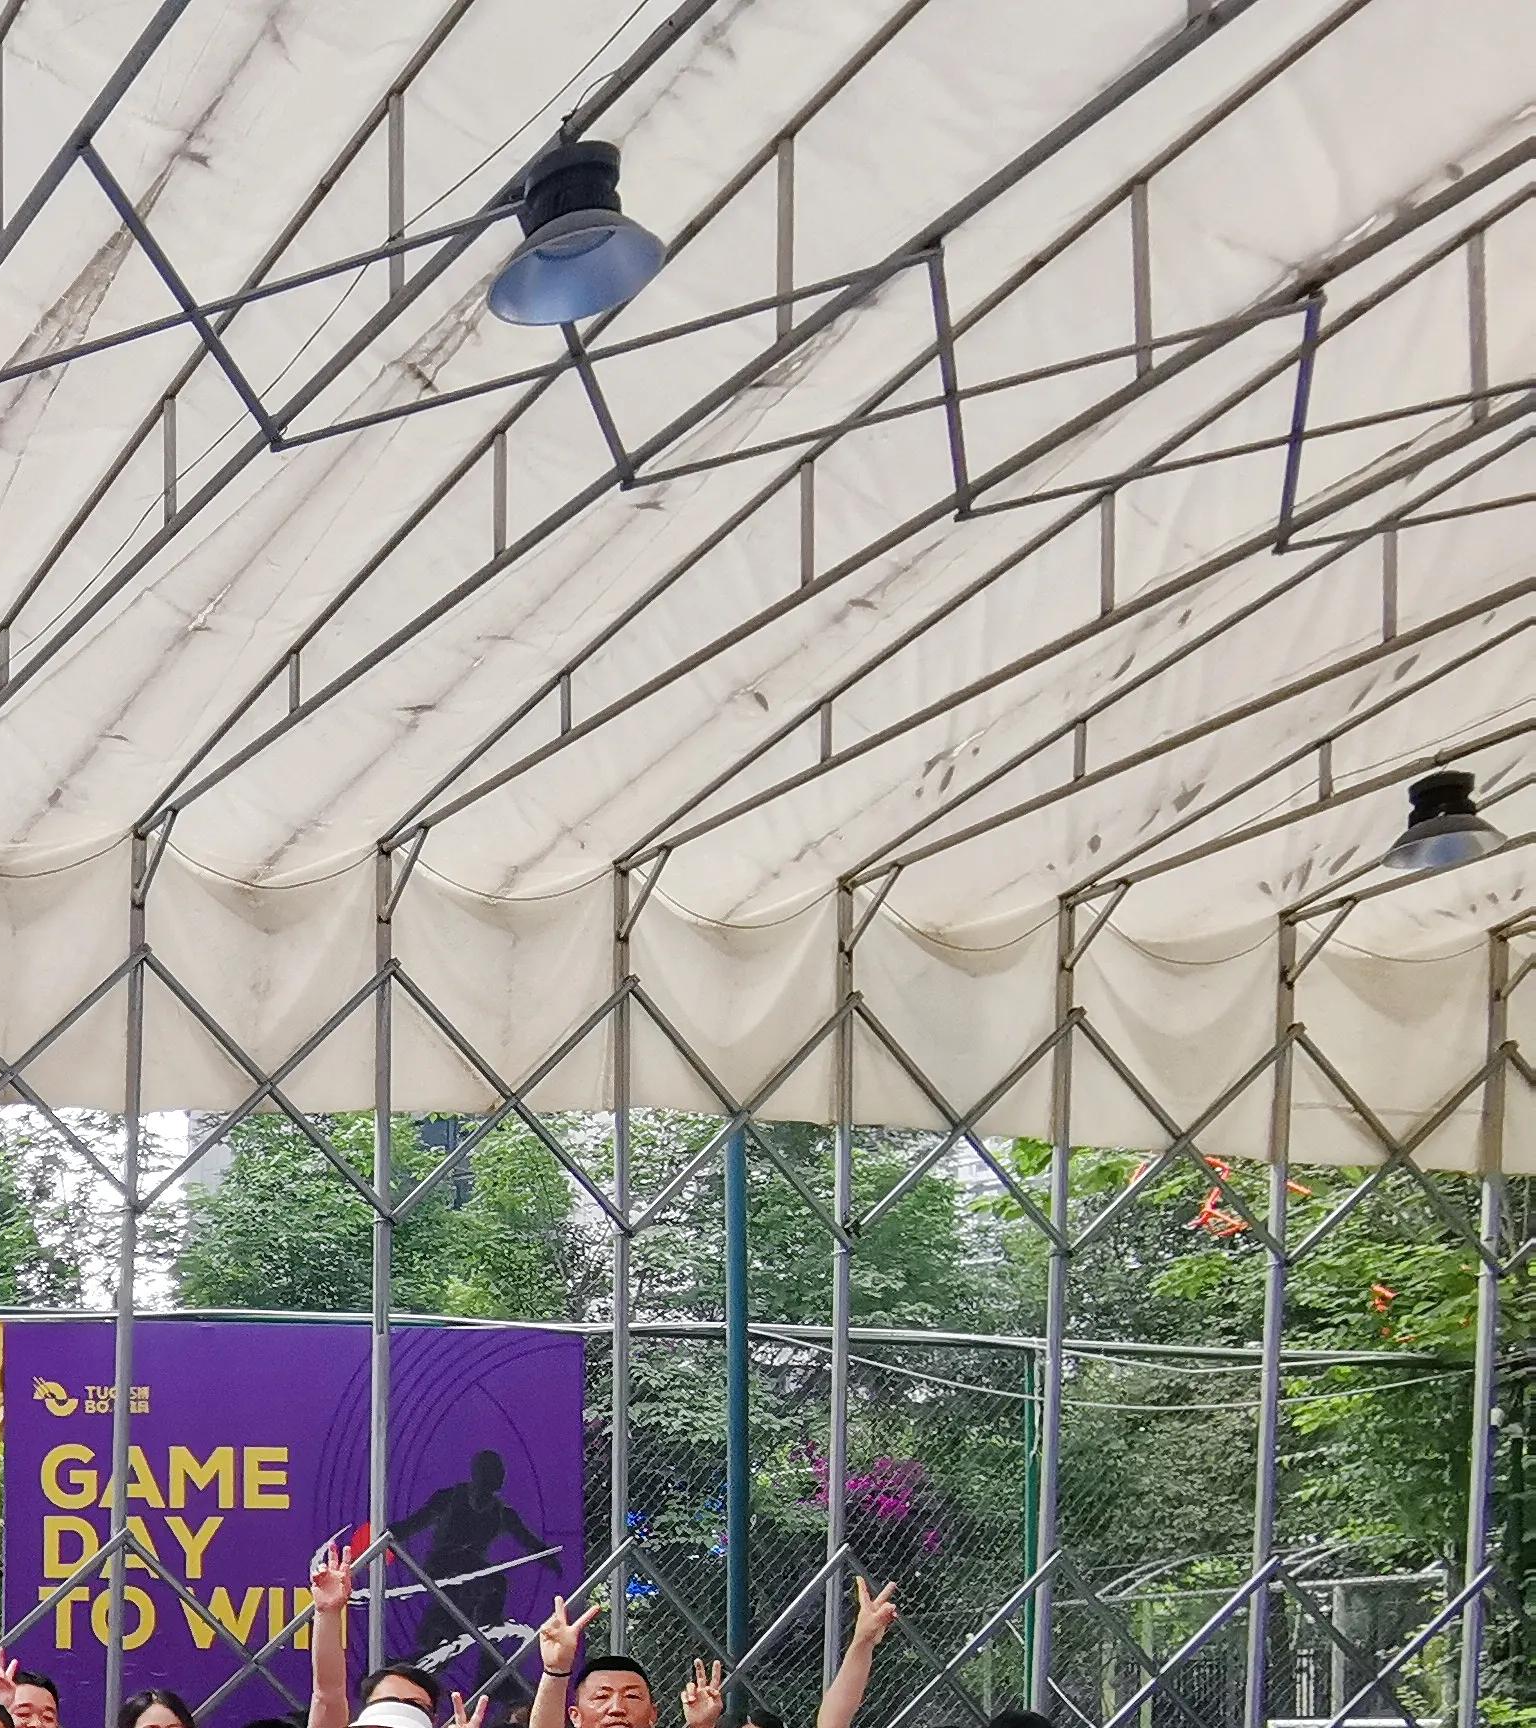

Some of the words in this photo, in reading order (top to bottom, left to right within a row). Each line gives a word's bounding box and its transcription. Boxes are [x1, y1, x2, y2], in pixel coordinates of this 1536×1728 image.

[84, 1400, 110, 1413] BO
[40, 1444, 290, 1510] GAME
[43, 1515, 224, 1579] DAY
[38, 1585, 156, 1650] TO
